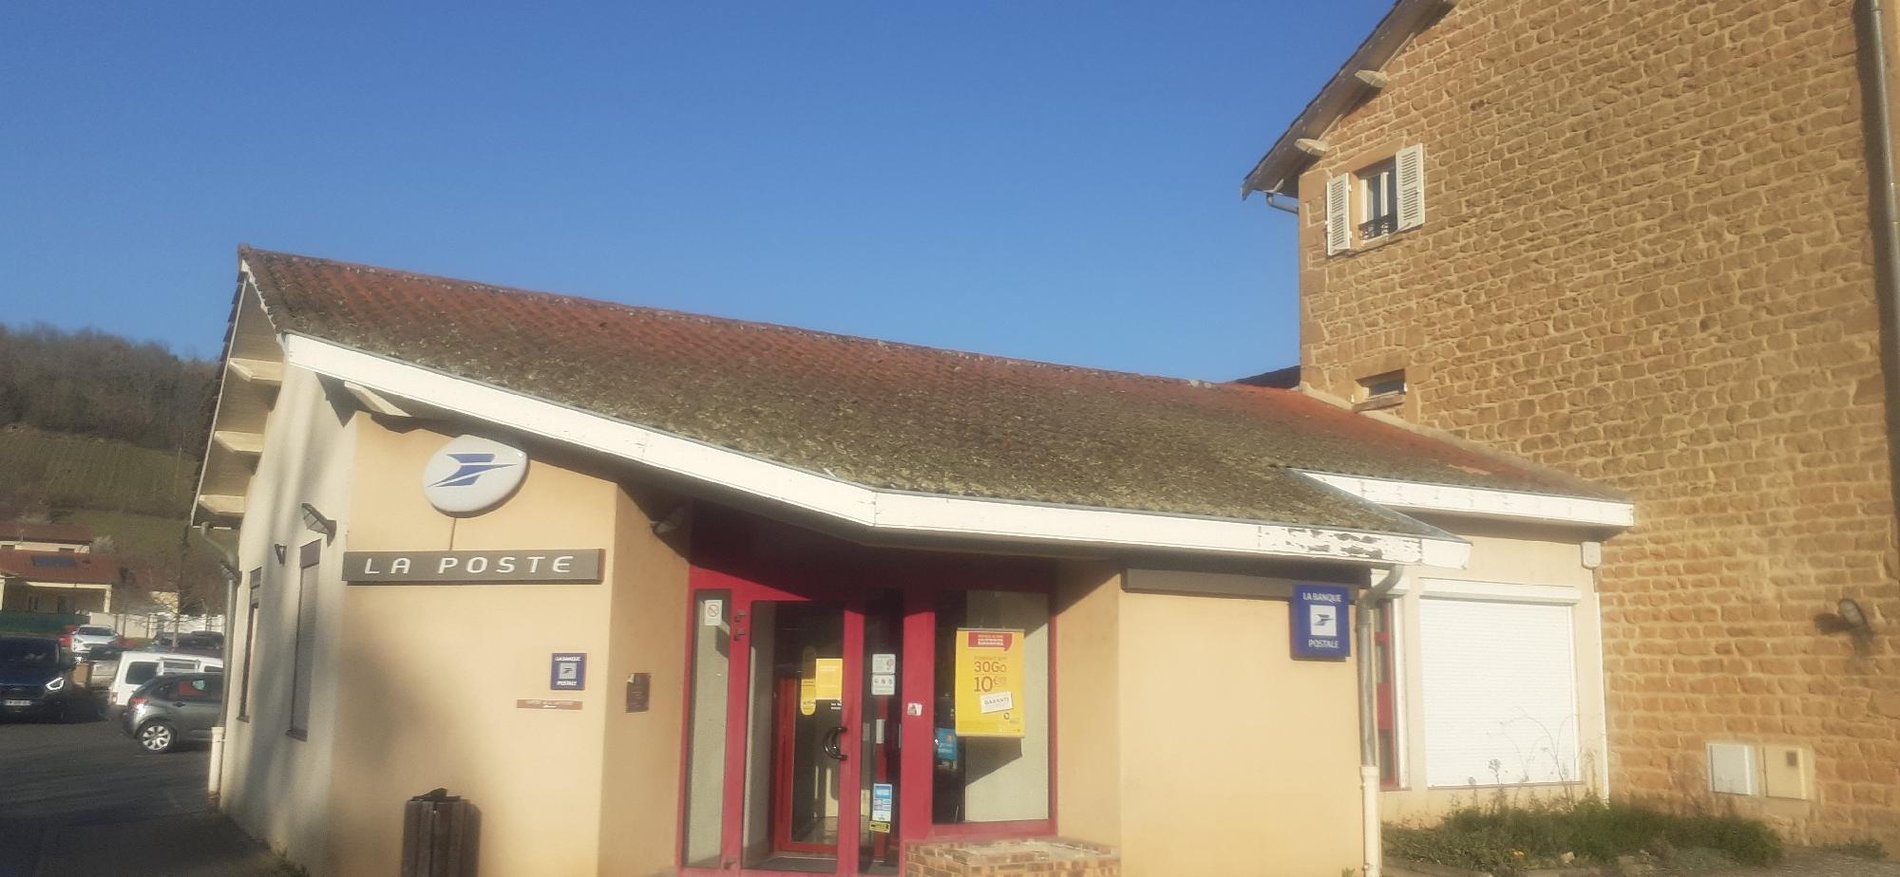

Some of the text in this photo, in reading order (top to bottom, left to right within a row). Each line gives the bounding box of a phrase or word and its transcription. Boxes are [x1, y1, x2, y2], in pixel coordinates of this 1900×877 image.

[364, 555, 574, 574] LA POSTE
[1302, 592, 1342, 602] LA BANQUE
[1308, 639, 1339, 648] POSTALE
[974, 660, 1007, 672] 30Go
